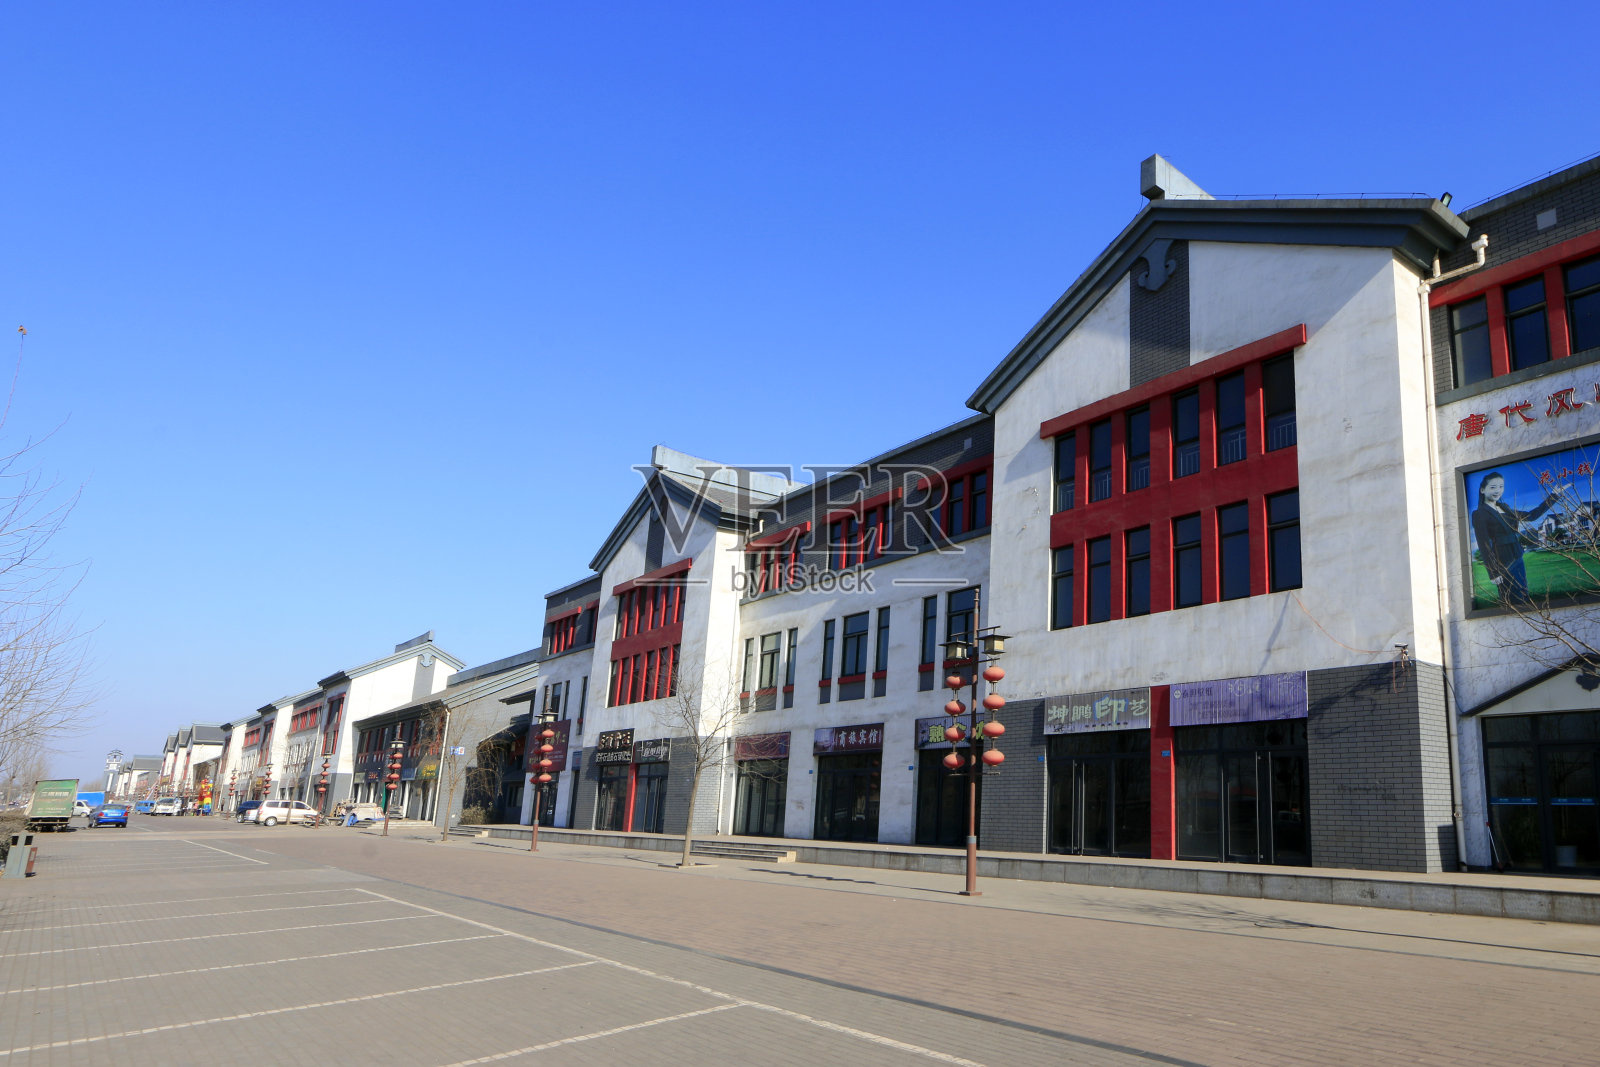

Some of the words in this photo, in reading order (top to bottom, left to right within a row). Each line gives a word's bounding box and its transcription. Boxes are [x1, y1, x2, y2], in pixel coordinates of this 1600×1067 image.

[1456, 382, 1600, 441] 唐代风
[1047, 695, 1149, 723] 坤鹏印艺
